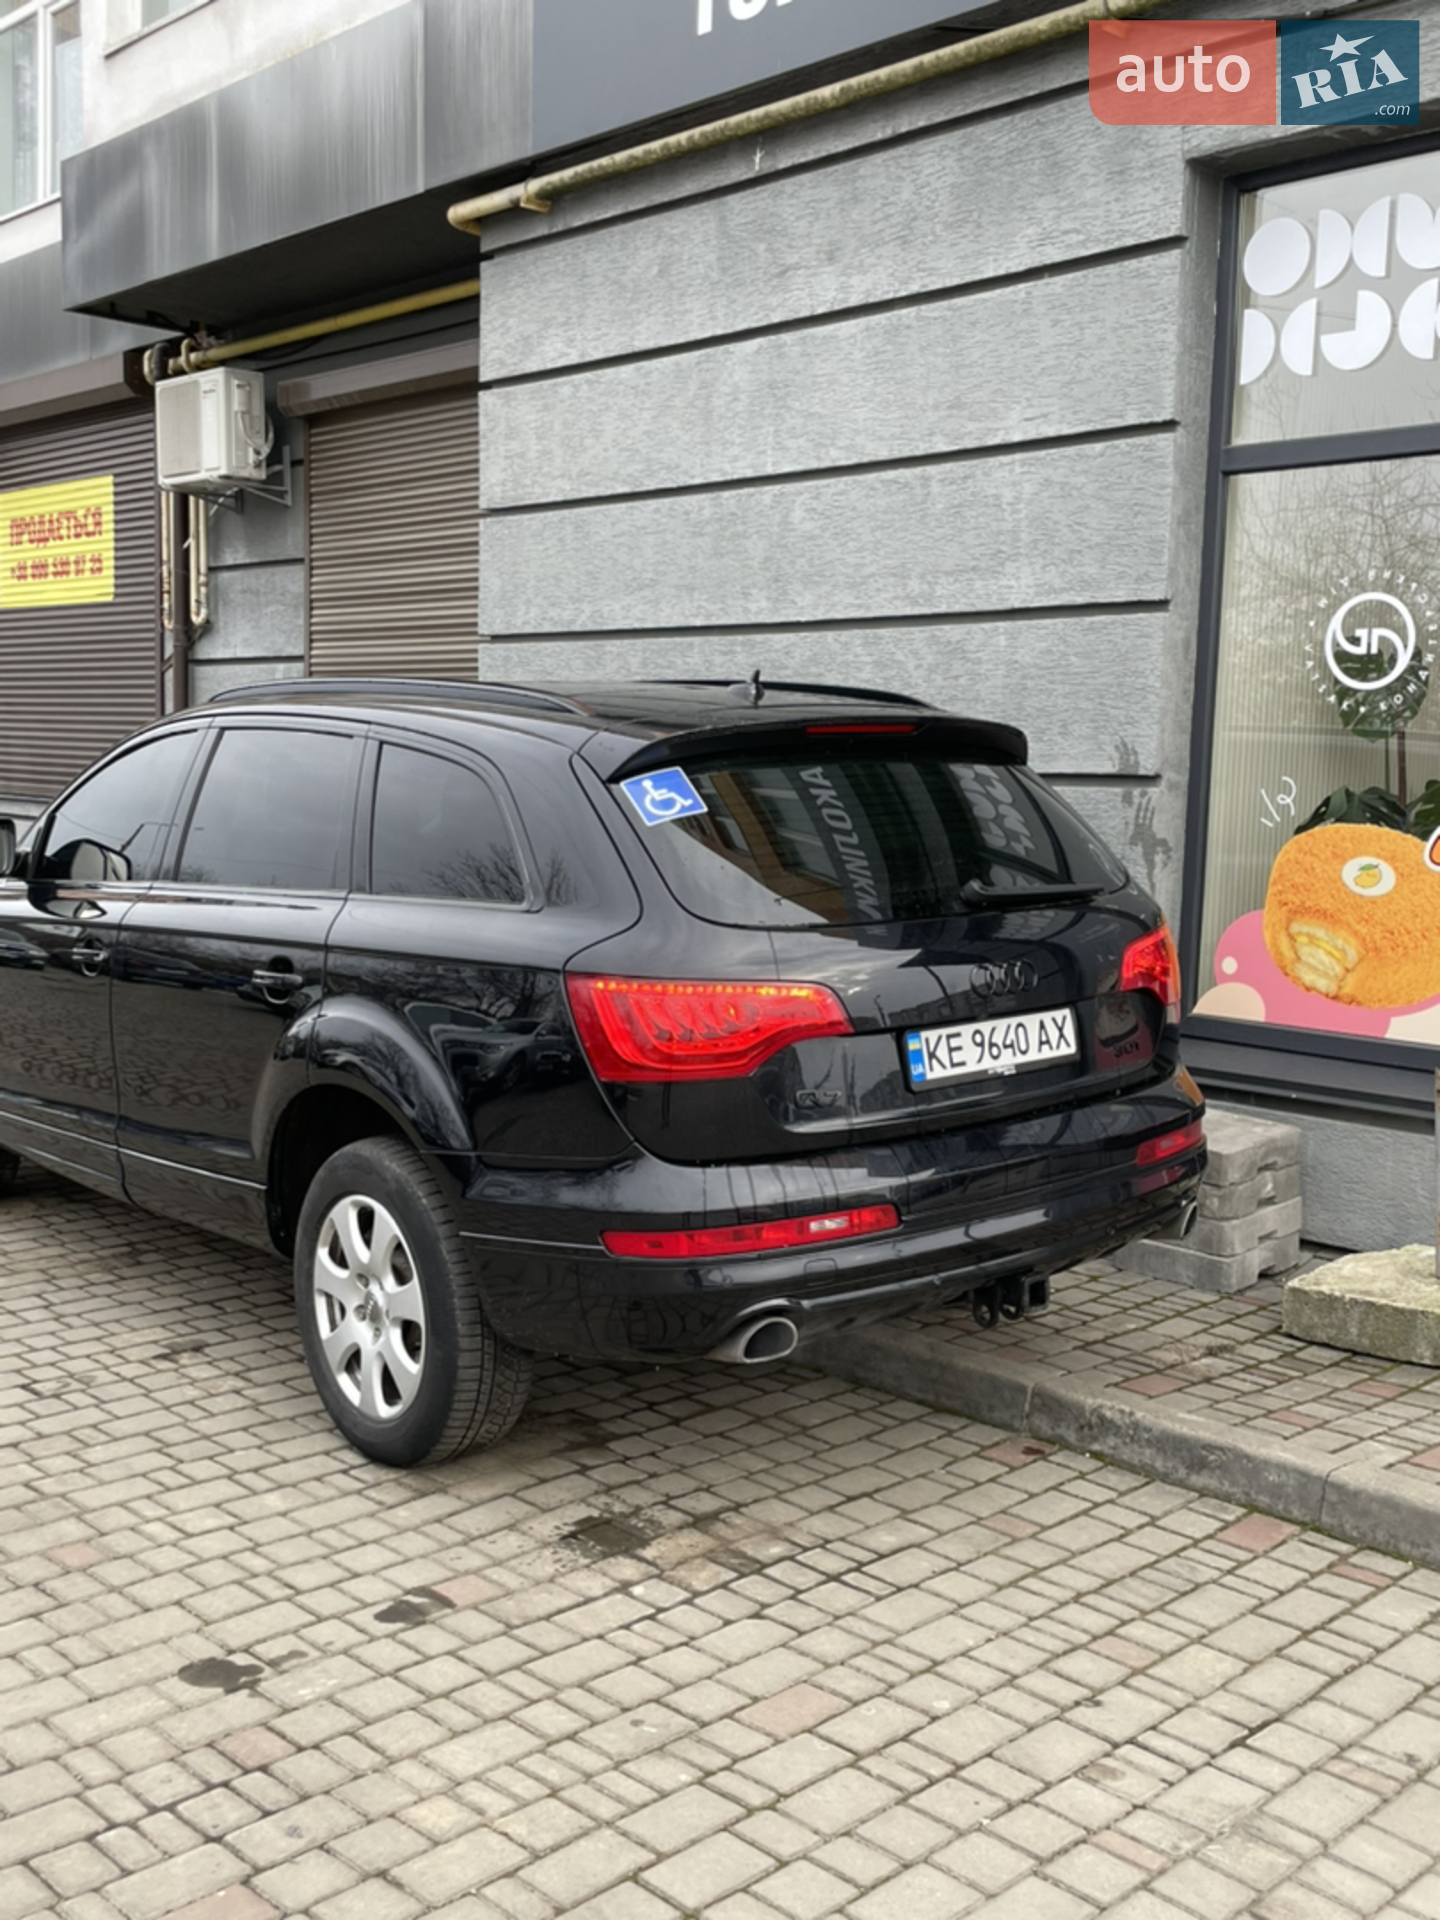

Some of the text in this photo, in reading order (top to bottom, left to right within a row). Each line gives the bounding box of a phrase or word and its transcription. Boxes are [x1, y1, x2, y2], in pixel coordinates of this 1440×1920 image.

[924, 1032, 967, 1073] KE
[970, 1021, 1030, 1065] 9640
[1037, 1014, 1072, 1053] AX
